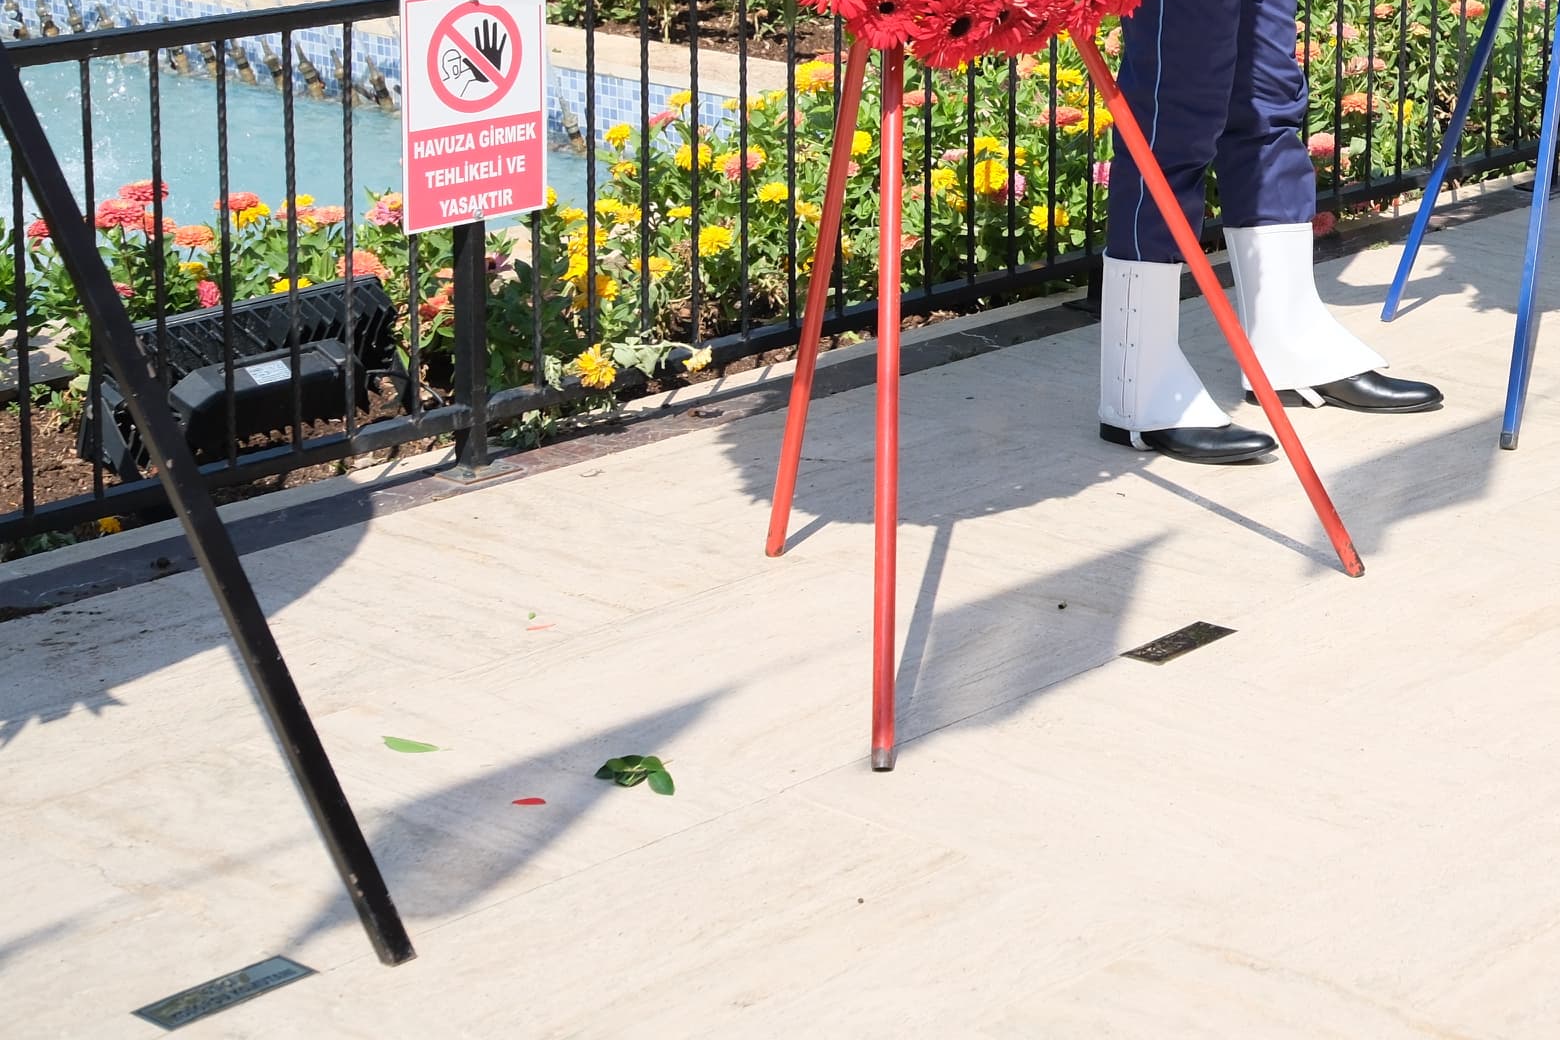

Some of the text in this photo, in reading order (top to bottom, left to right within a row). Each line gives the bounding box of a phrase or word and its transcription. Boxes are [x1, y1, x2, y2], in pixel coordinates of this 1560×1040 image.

[413, 122, 537, 159] HAVUZA GİRMEK
[425, 155, 526, 189] TEHLİKELİ VE
[439, 188, 513, 218] YASAKTIR
